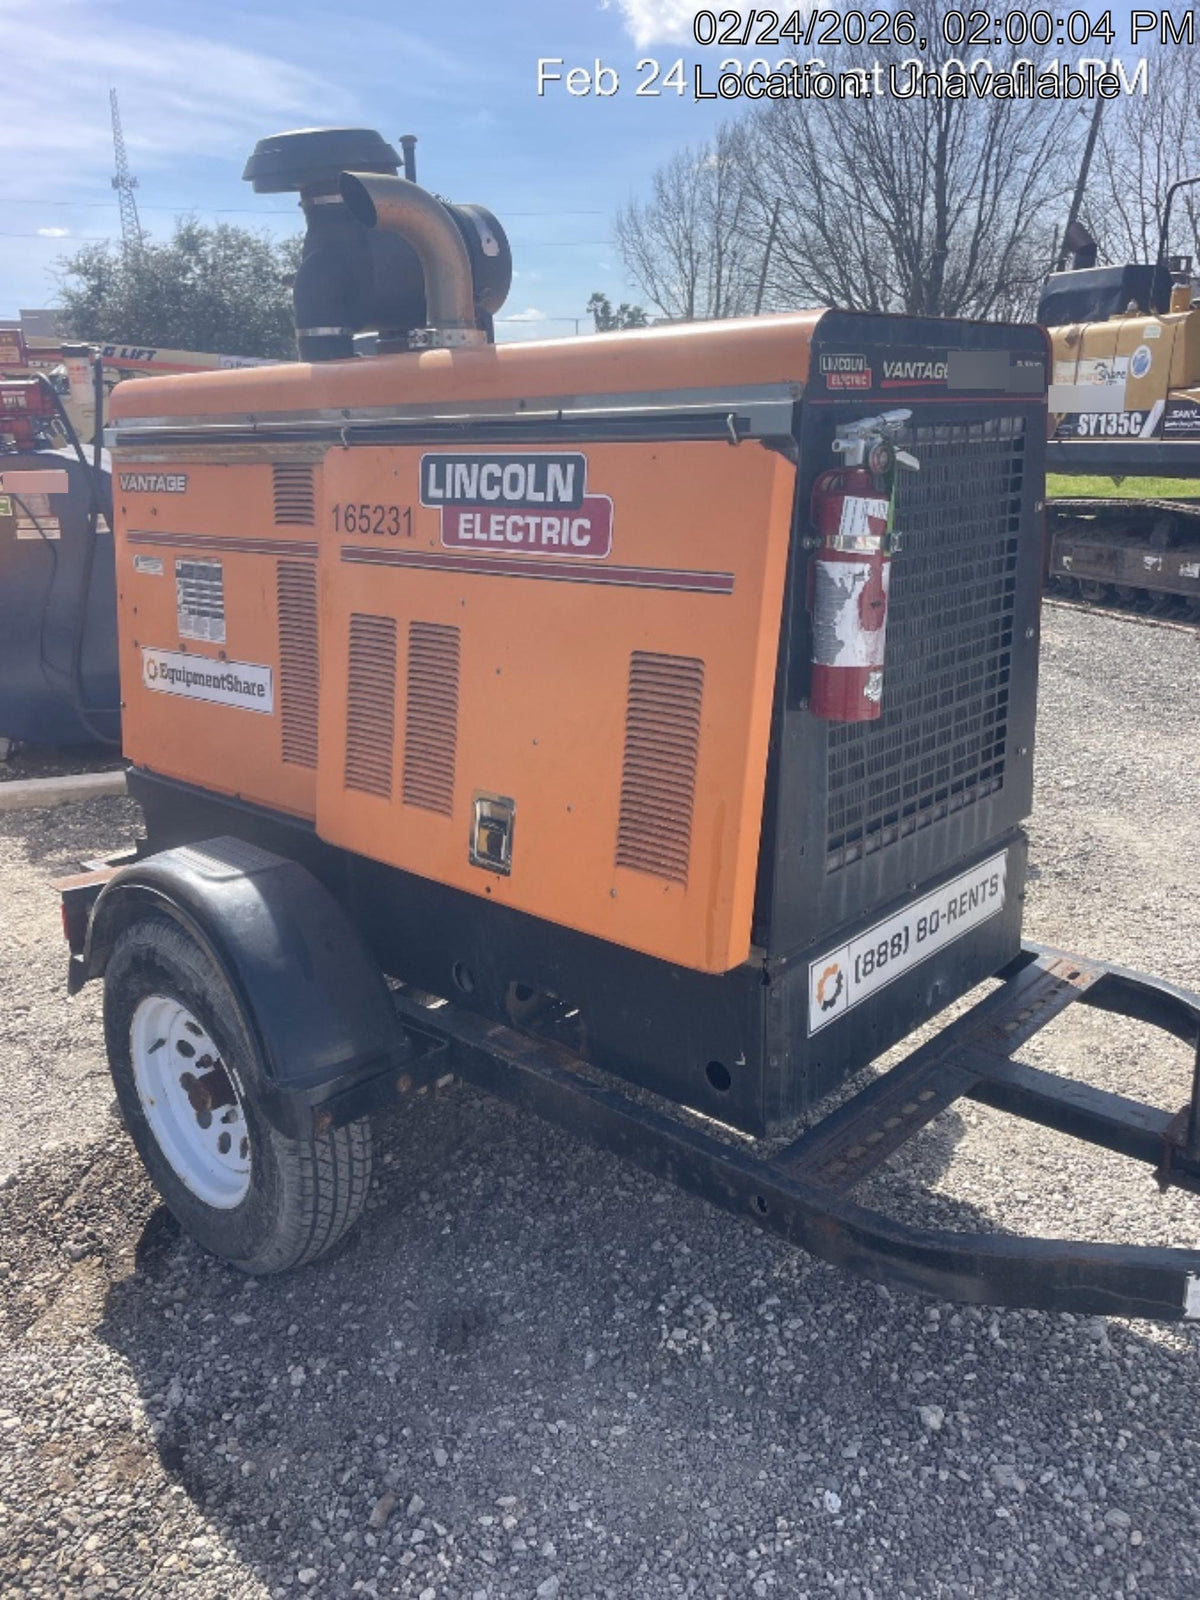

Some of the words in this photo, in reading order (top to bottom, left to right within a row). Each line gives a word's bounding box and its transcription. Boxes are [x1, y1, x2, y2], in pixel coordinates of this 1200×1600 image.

[822, 356, 864, 371] LINCOLN
[1077, 412, 1143, 436] SY135C
[118, 472, 188, 493] VANTAGE
[427, 462, 575, 503] LINCOLN
[331, 503, 413, 538] 165231
[458, 512, 592, 548] ELECTRIC
[159, 662, 266, 697] EquipmentShare
[854, 925, 910, 984] (888)
